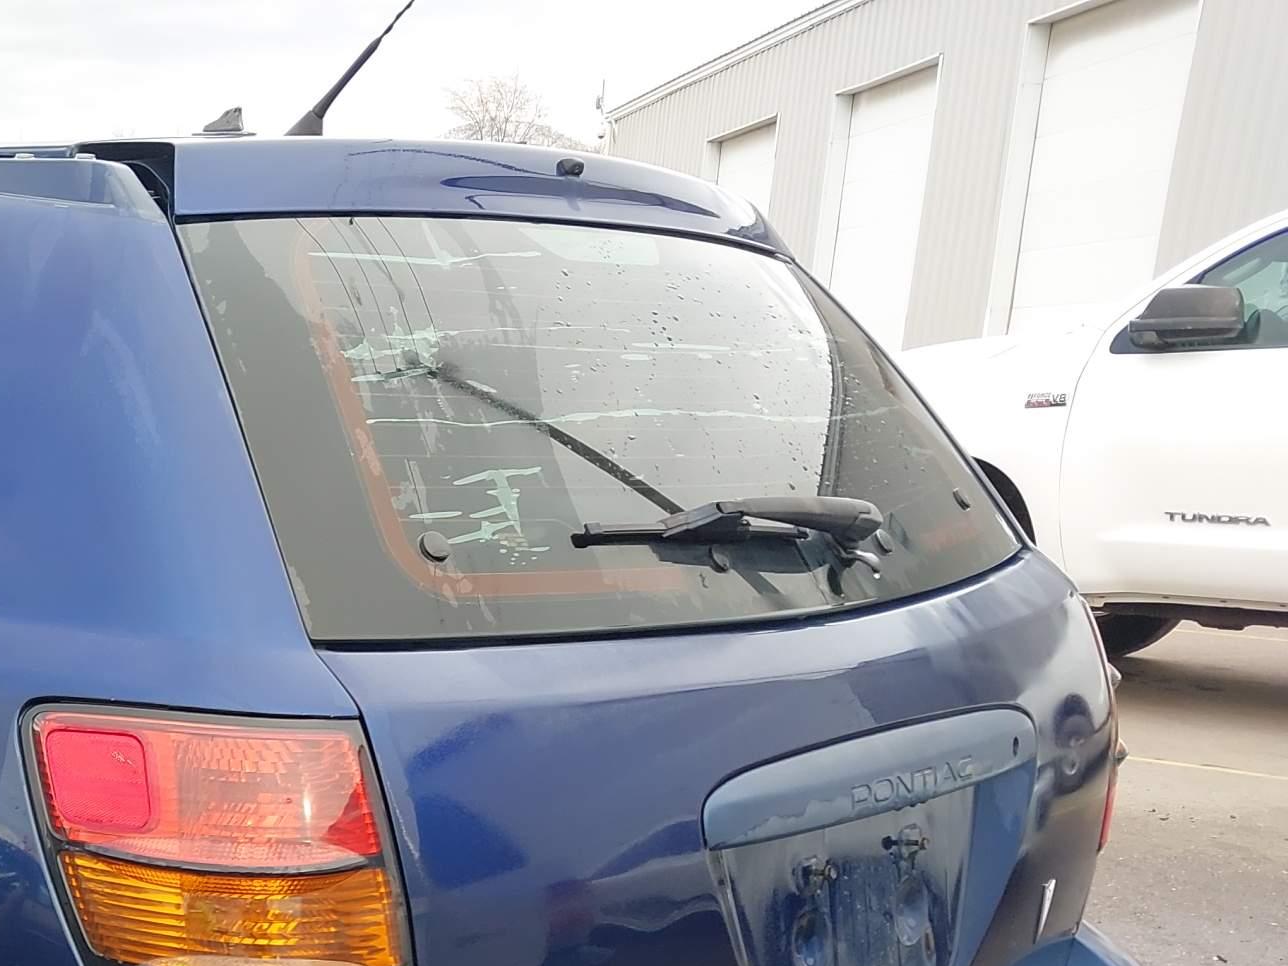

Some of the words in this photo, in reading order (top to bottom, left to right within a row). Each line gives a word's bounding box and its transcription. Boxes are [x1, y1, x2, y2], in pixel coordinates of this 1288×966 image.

[1052, 393, 1067, 403] V8
[1164, 511, 1271, 527] TUNDRA
[850, 754, 974, 811] PONTIAC
